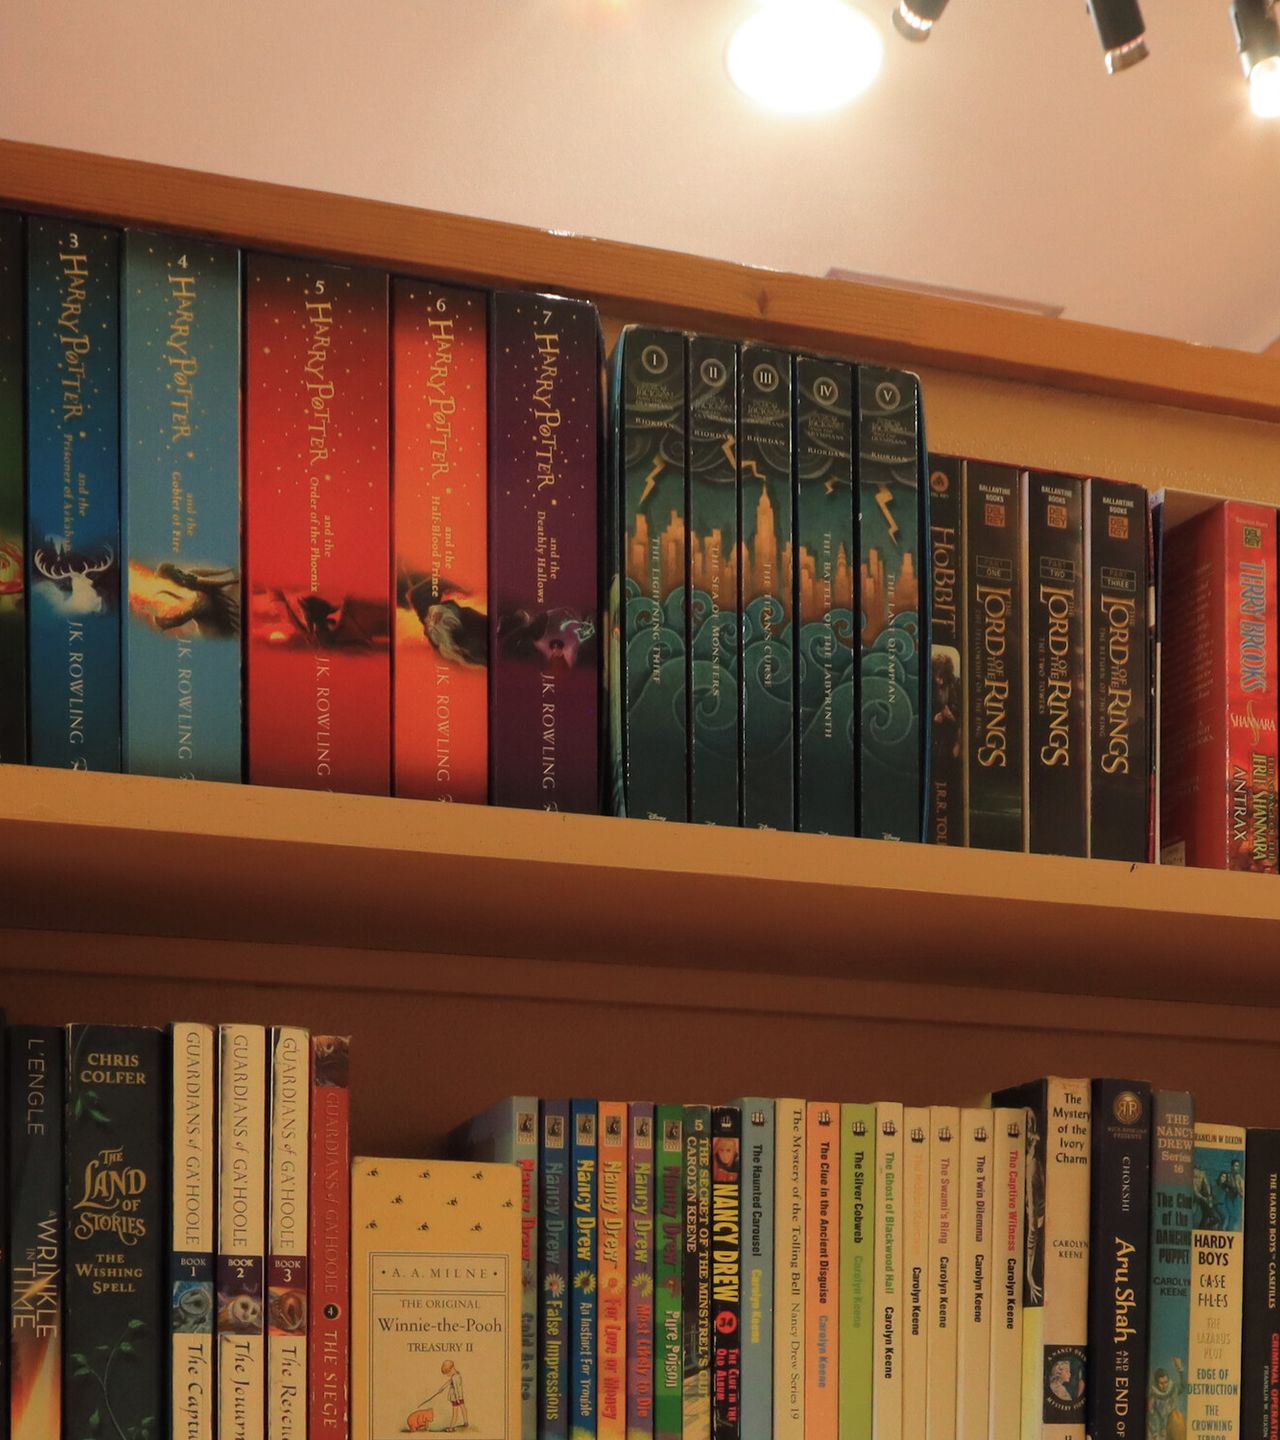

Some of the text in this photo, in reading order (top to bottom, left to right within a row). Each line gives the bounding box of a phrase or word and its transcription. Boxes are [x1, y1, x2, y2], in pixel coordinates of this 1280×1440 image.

[58, 253, 90, 421] HARRY POTTER
[168, 275, 198, 442] HARRY POTTER
[305, 302, 335, 464] HARRY POTTER
[429, 396, 456, 478] POTTER
[534, 409, 561, 491] POTTER
[931, 526, 956, 639] HOBBIT
[976, 584, 1012, 655] LORD
[1040, 584, 1075, 656] LORD
[1240, 559, 1267, 693] TERRY BROOKS
[68, 653, 84, 744] ROWLING
[178, 668, 193, 760] ROWLING
[317, 687, 331, 776] ROWLING
[437, 695, 450, 782] ROWLING
[978, 680, 1009, 768] RINGS
[1041, 679, 1072, 768] RINGS
[1101, 687, 1132, 775] RINGS
[542, 704, 555, 790] ROWLING
[1233, 766, 1248, 841] ANTRAX
[26, 1039, 46, 1137] L'ENGLE
[80, 1069, 147, 1085] COLFER
[87, 1052, 140, 1067] CHRIS
[185, 1032, 202, 1139] GUARDIANS
[232, 1033, 249, 1248] GUARDIANS GA'HOOLE
[1055, 1152, 1088, 1165] Charm
[72, 1160, 147, 1210] LAND
[574, 1160, 596, 1260] Nancy Drew
[687, 1136, 698, 1254] CAROLYN KEENE
[74, 1210, 147, 1247] STORIES
[713, 1184, 739, 1303] NANCY DREW
[884, 1213, 895, 1270] Blackwood
[1194, 1234, 1234, 1249] HARDY
[1198, 1252, 1229, 1266] BOYS
[36, 1218, 59, 1339] WRINKLE
[75, 1264, 144, 1280] WISHING
[92, 1281, 137, 1295] SPELL
[425, 1299, 481, 1309] ORIGINAL
[430, 1268, 489, 1280] MILNE
[1115, 1236, 1138, 1344] Aru Shah
[377, 1316, 503, 1333] Winnie-the-Pooh
[407, 1342, 462, 1353] TREASURY
[323, 1372, 338, 1428] SIEGE
[544, 1340, 562, 1421] Impressions
[1114, 1377, 1129, 1417] END
[1187, 1383, 1238, 1396] DESTRUCTION
